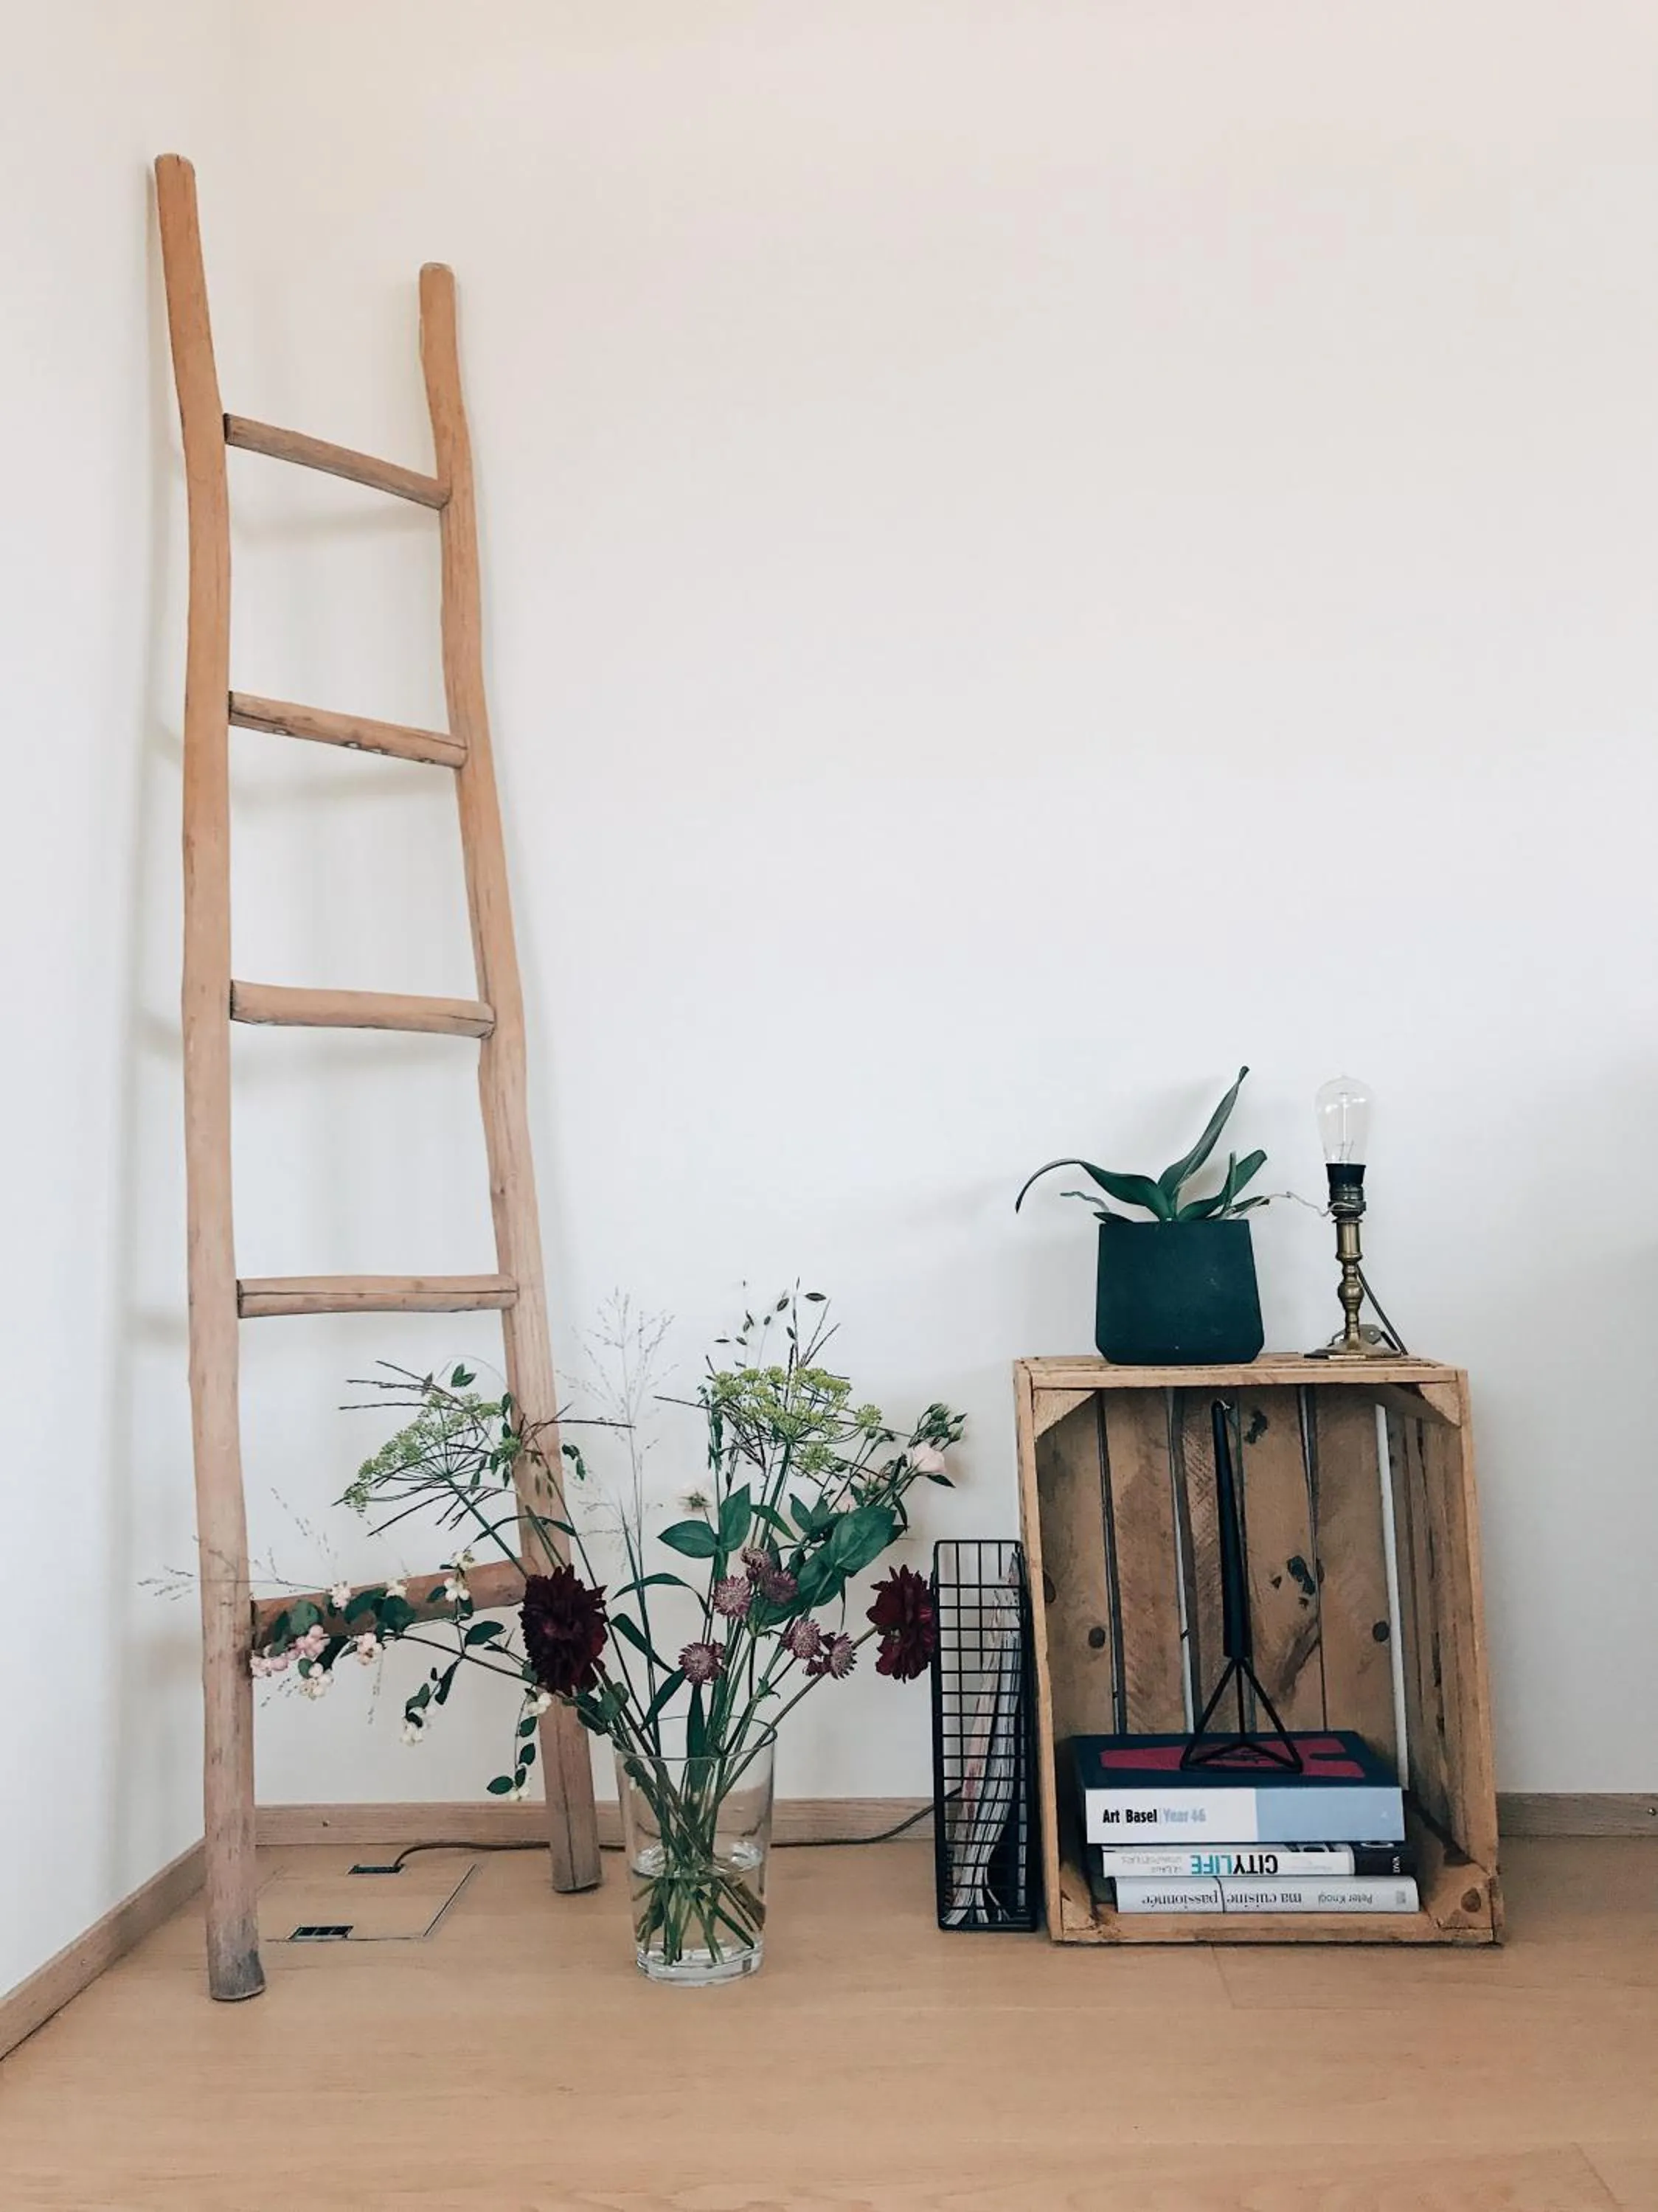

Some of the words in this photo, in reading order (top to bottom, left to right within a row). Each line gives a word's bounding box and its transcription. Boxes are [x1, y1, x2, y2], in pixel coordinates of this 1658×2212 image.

[1103, 1809, 1120, 1823] Art
[1125, 1809, 1156, 1823] Basel
[1163, 1809, 1187, 1823] Year
[1191, 1808, 1206, 1822] 46
[1190, 1854, 1278, 1874] CITYLIFE
[1142, 1890, 1218, 1907] passionnée
[1227, 1893, 1277, 1907] cuisine
[1281, 1893, 1302, 1903] ma
[1349, 1892, 1373, 1905] Peter
